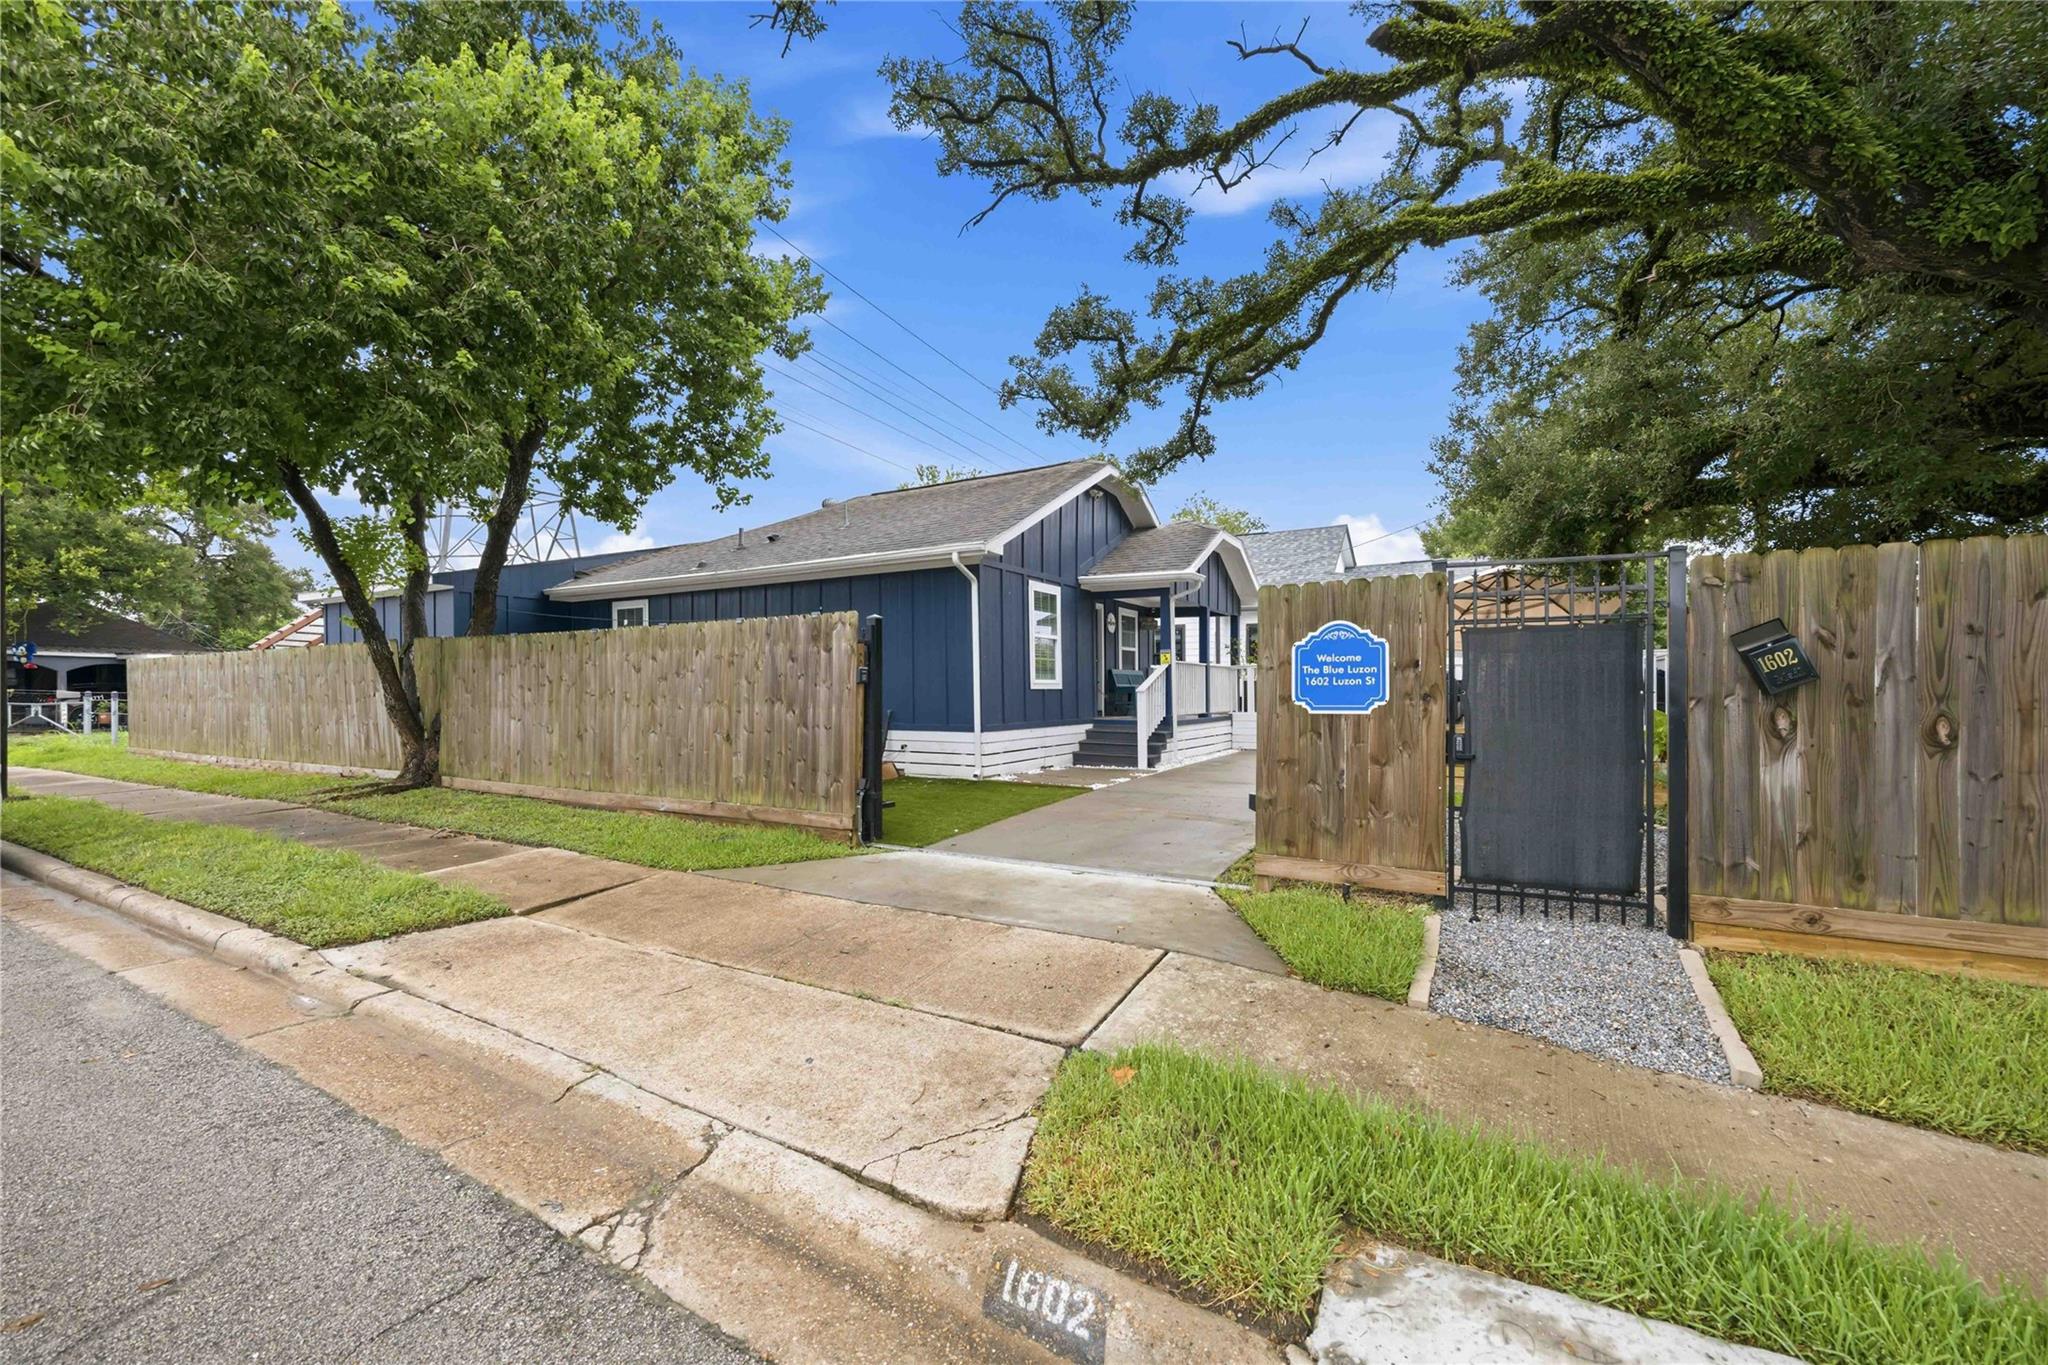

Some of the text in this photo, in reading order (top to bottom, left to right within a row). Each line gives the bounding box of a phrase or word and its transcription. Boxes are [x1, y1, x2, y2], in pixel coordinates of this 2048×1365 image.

[1316, 653, 1362, 662] Welcome
[1757, 648, 1799, 673] 1602
[1302, 665, 1378, 674] The Blue Luzon
[1305, 676, 1376, 686] 1602 Luzon St
[1002, 1257, 1096, 1341] 1602
